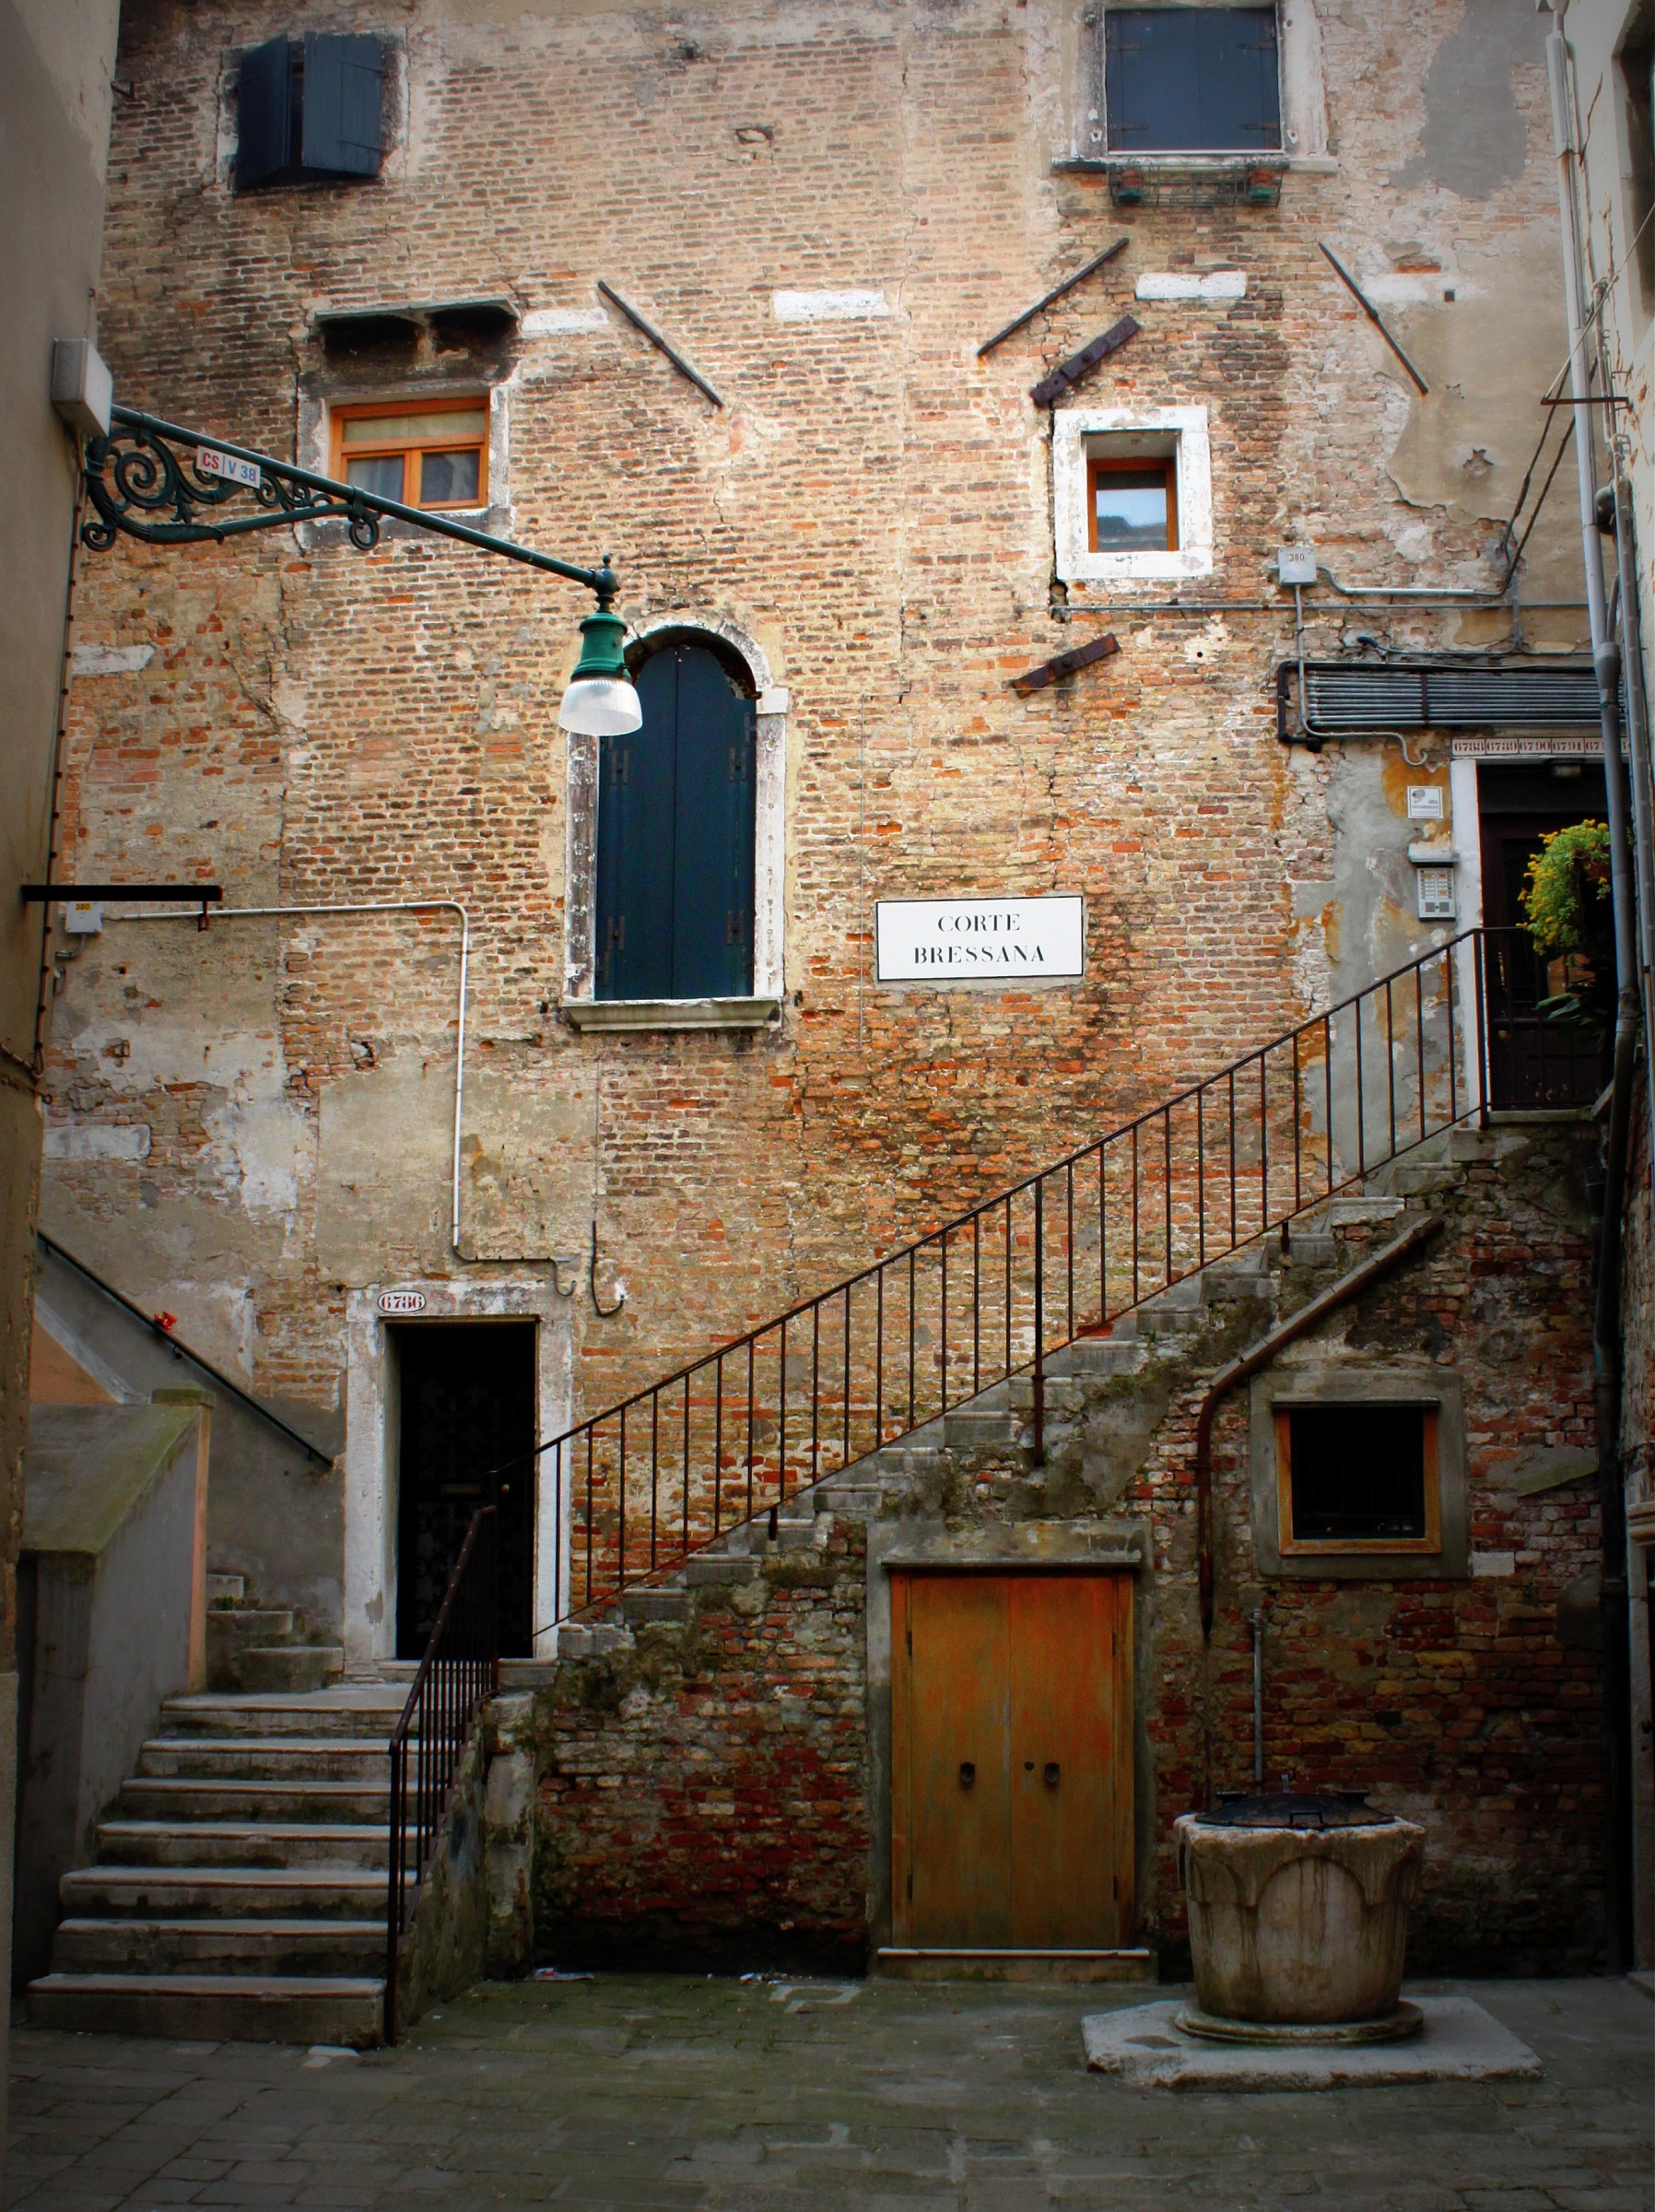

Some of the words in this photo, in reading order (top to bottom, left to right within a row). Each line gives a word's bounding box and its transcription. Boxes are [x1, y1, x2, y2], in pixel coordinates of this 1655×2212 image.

[202, 453, 219, 470] CS
[228, 460, 237, 475] V
[241, 465, 256, 482] 38
[1454, 742, 1485, 751] 6788
[1486, 742, 1518, 751] 6789
[1520, 742, 1551, 751] 6790
[1553, 742, 1581, 751] 6791
[937, 913, 1021, 933] CORTE
[914, 944, 1045, 964] BRESSANA
[381, 1296, 423, 1309] 6786
